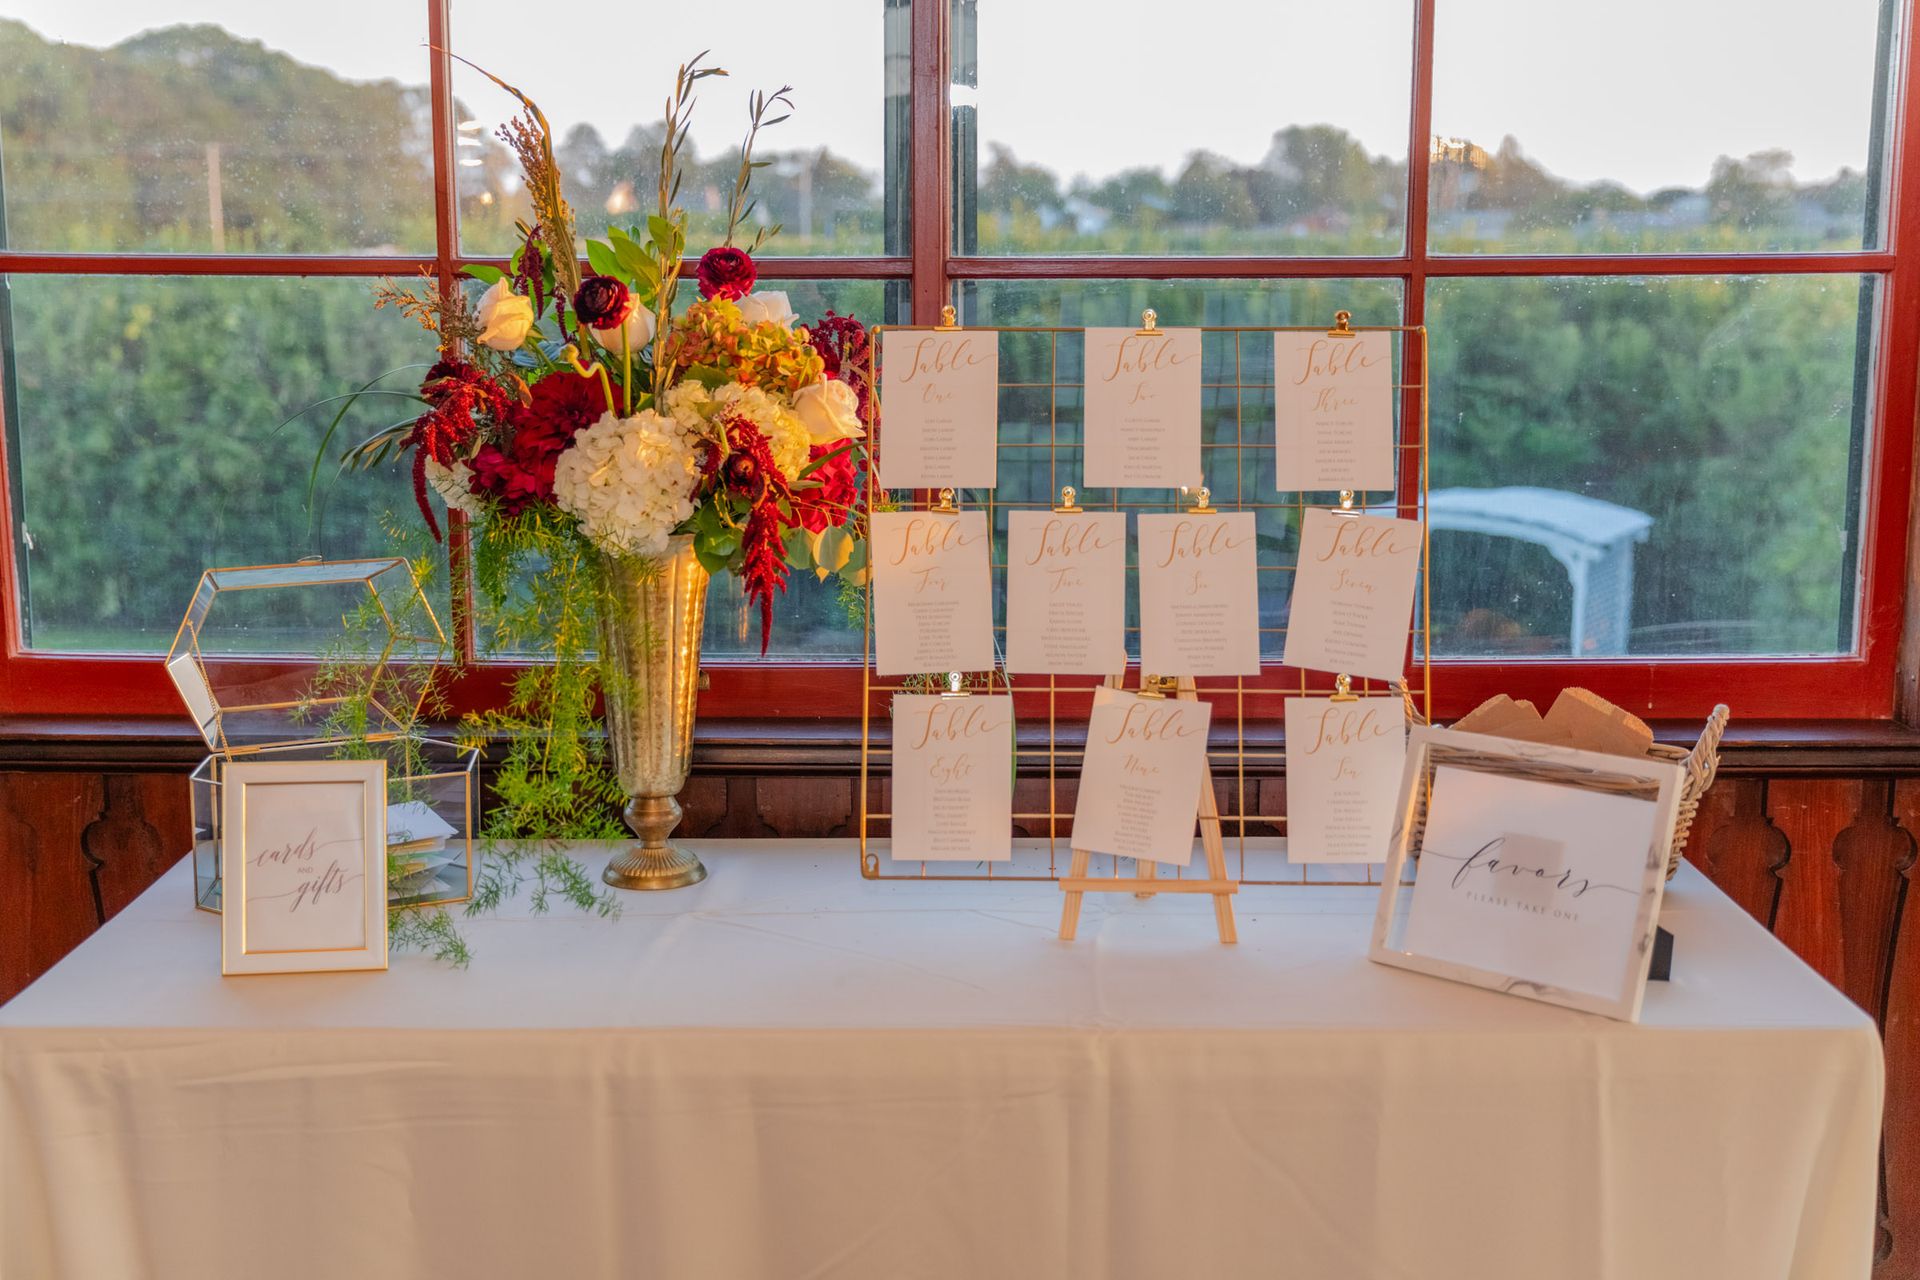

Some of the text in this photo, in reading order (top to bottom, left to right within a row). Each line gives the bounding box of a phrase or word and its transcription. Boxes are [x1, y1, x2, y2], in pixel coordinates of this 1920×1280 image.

[899, 337, 997, 383] Table
[1103, 336, 1200, 382] Table
[1294, 339, 1391, 385] Table
[922, 383, 953, 403] One
[1312, 386, 1359, 412] Three
[889, 519, 987, 566] Table
[1025, 520, 1124, 566] Table
[1157, 521, 1256, 568] Table
[1316, 520, 1418, 562] Table
[1330, 569, 1377, 595] Seven
[910, 703, 1010, 750] Table
[1105, 702, 1207, 745] Table
[1305, 707, 1404, 755] Table
[930, 753, 976, 785] Eight
[1122, 753, 1161, 776] Nine
[1330, 756, 1362, 781] Ten
[1421, 836, 1641, 898] favors
[1466, 890, 1580, 922] PLEASE TAKE ONE
